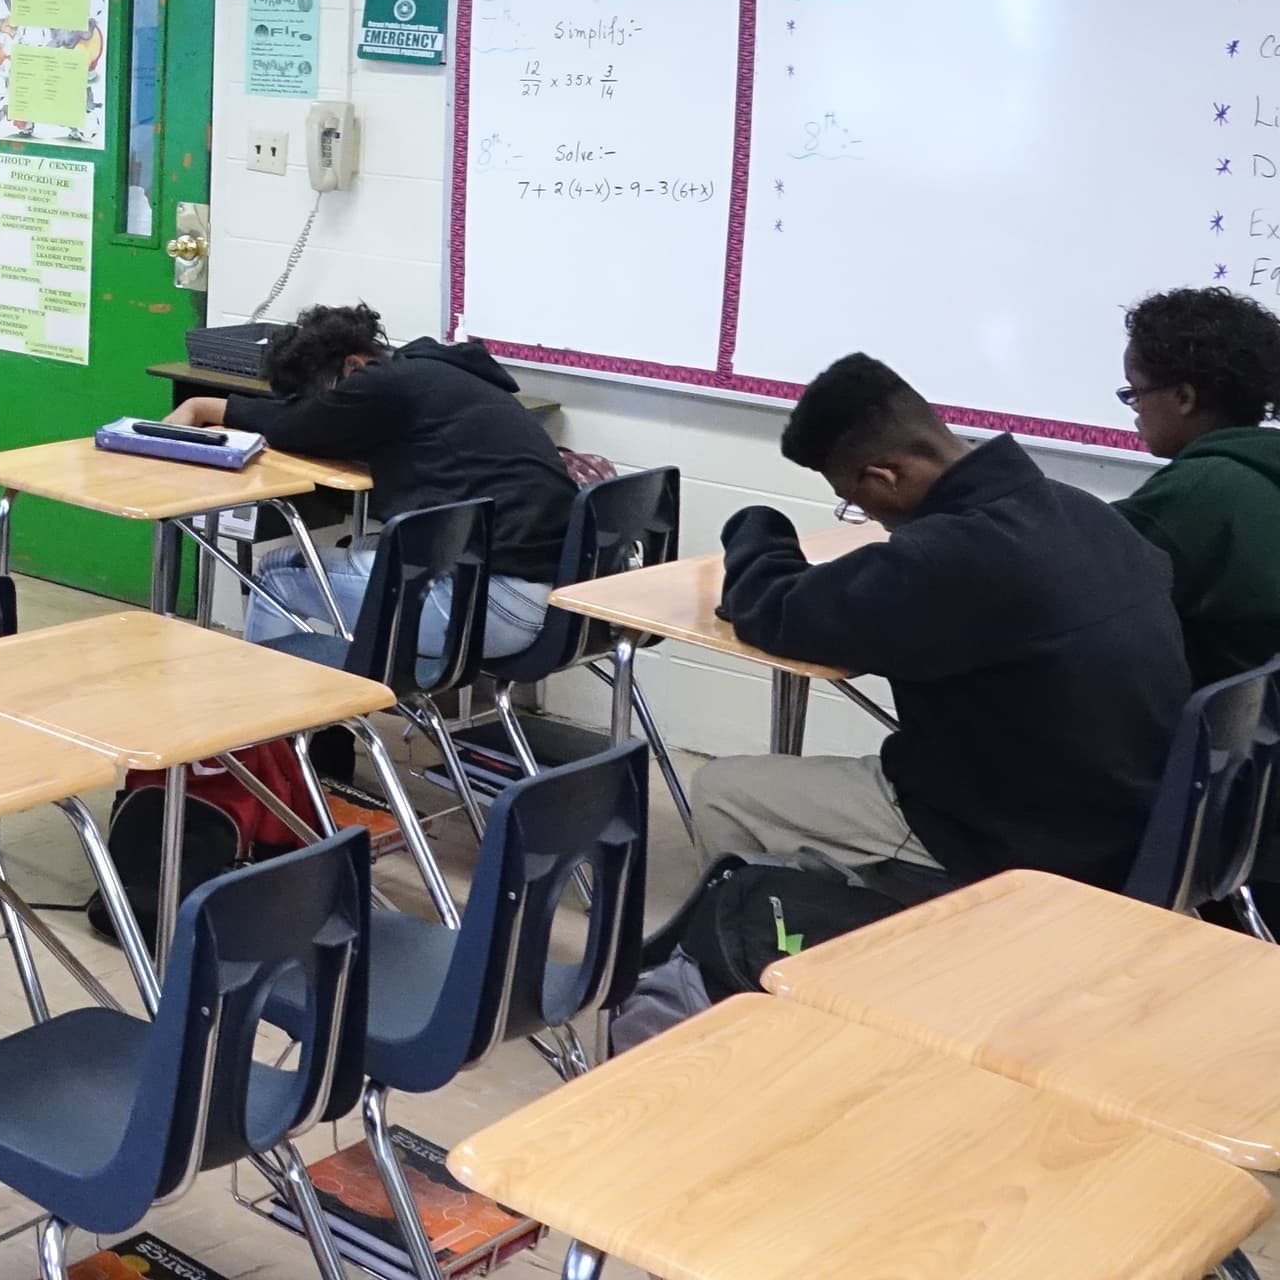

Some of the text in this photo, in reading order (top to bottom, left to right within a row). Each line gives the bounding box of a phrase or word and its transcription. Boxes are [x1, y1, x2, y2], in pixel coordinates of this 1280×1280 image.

[271, 26, 312, 41] Fire
[364, 29, 438, 49] EMERGENCY
[49, 161, 88, 172] CENTER
[11, 171, 70, 188] PROCEDURE
